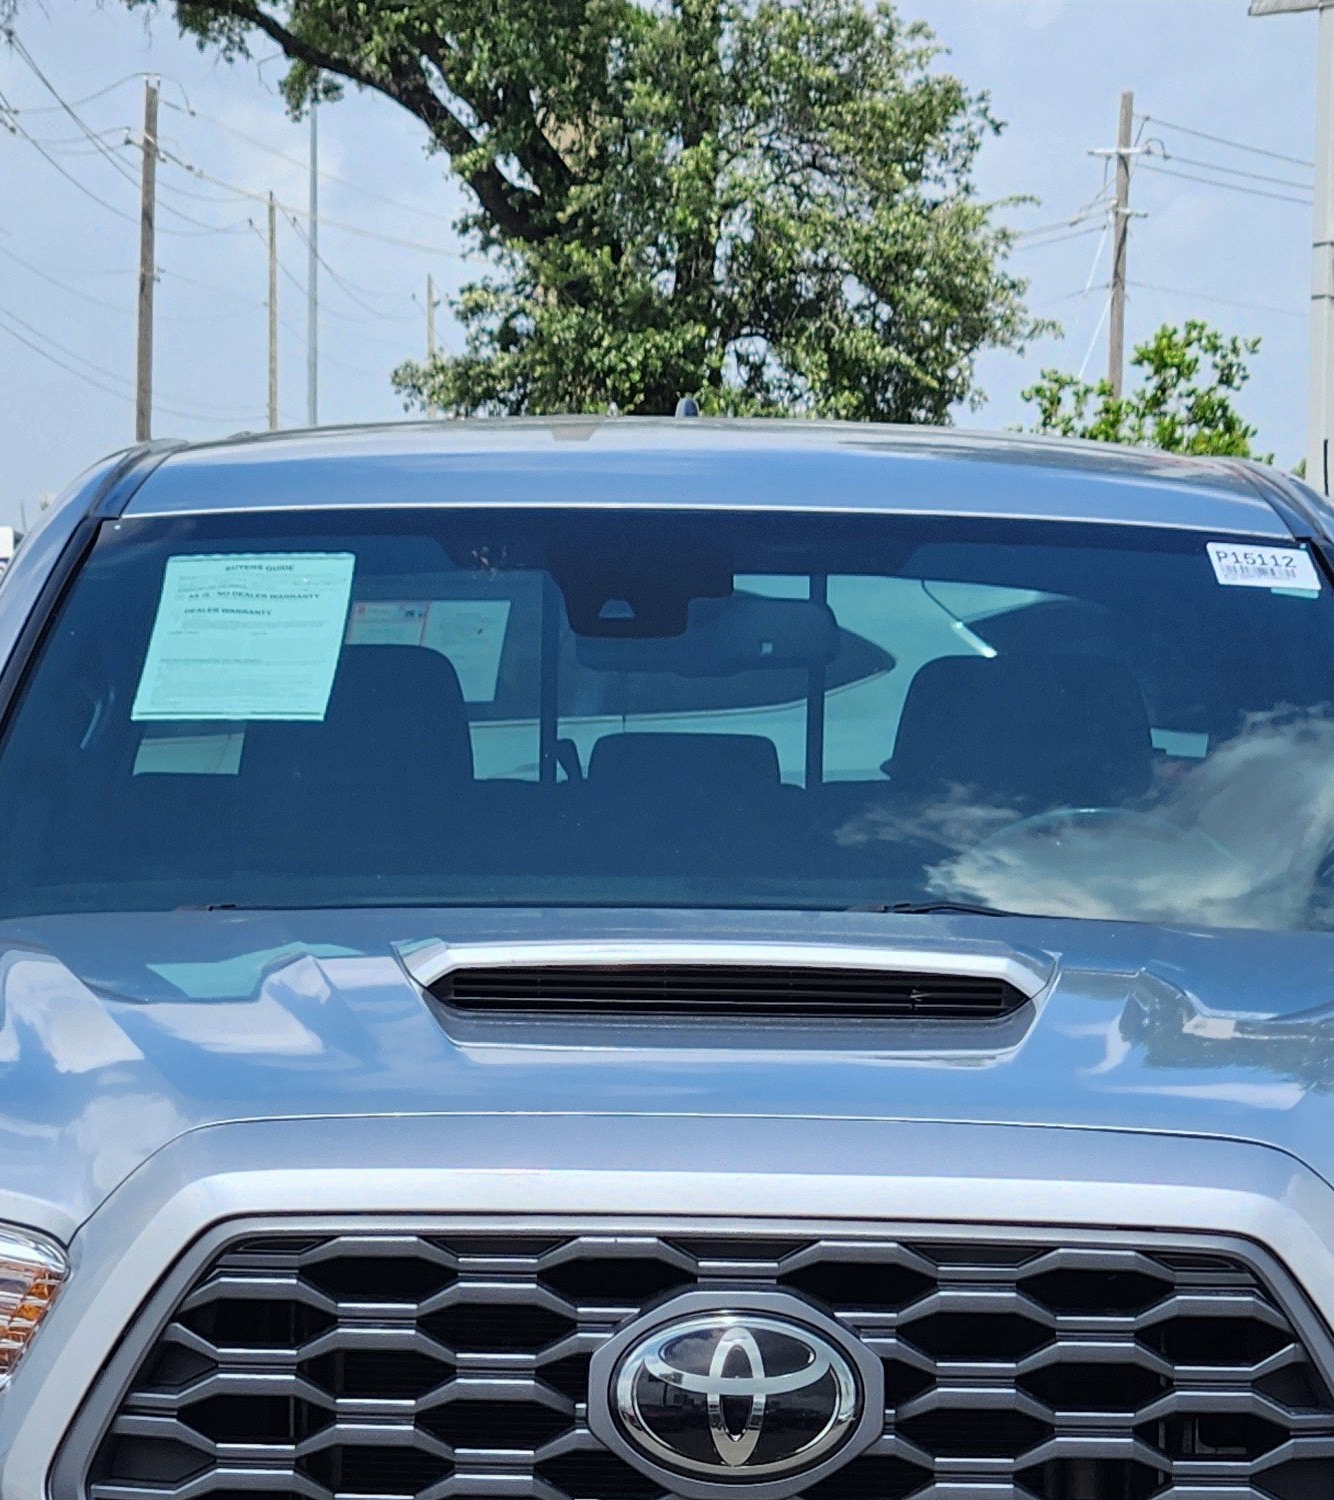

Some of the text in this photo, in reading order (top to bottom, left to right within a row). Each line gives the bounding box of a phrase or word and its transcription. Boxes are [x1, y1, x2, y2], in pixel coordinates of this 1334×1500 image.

[1216, 550, 1296, 568] P15112
[266, 564, 294, 572] GUIDE
[232, 591, 268, 599] DEALER
[221, 608, 272, 616] WARRANTY
